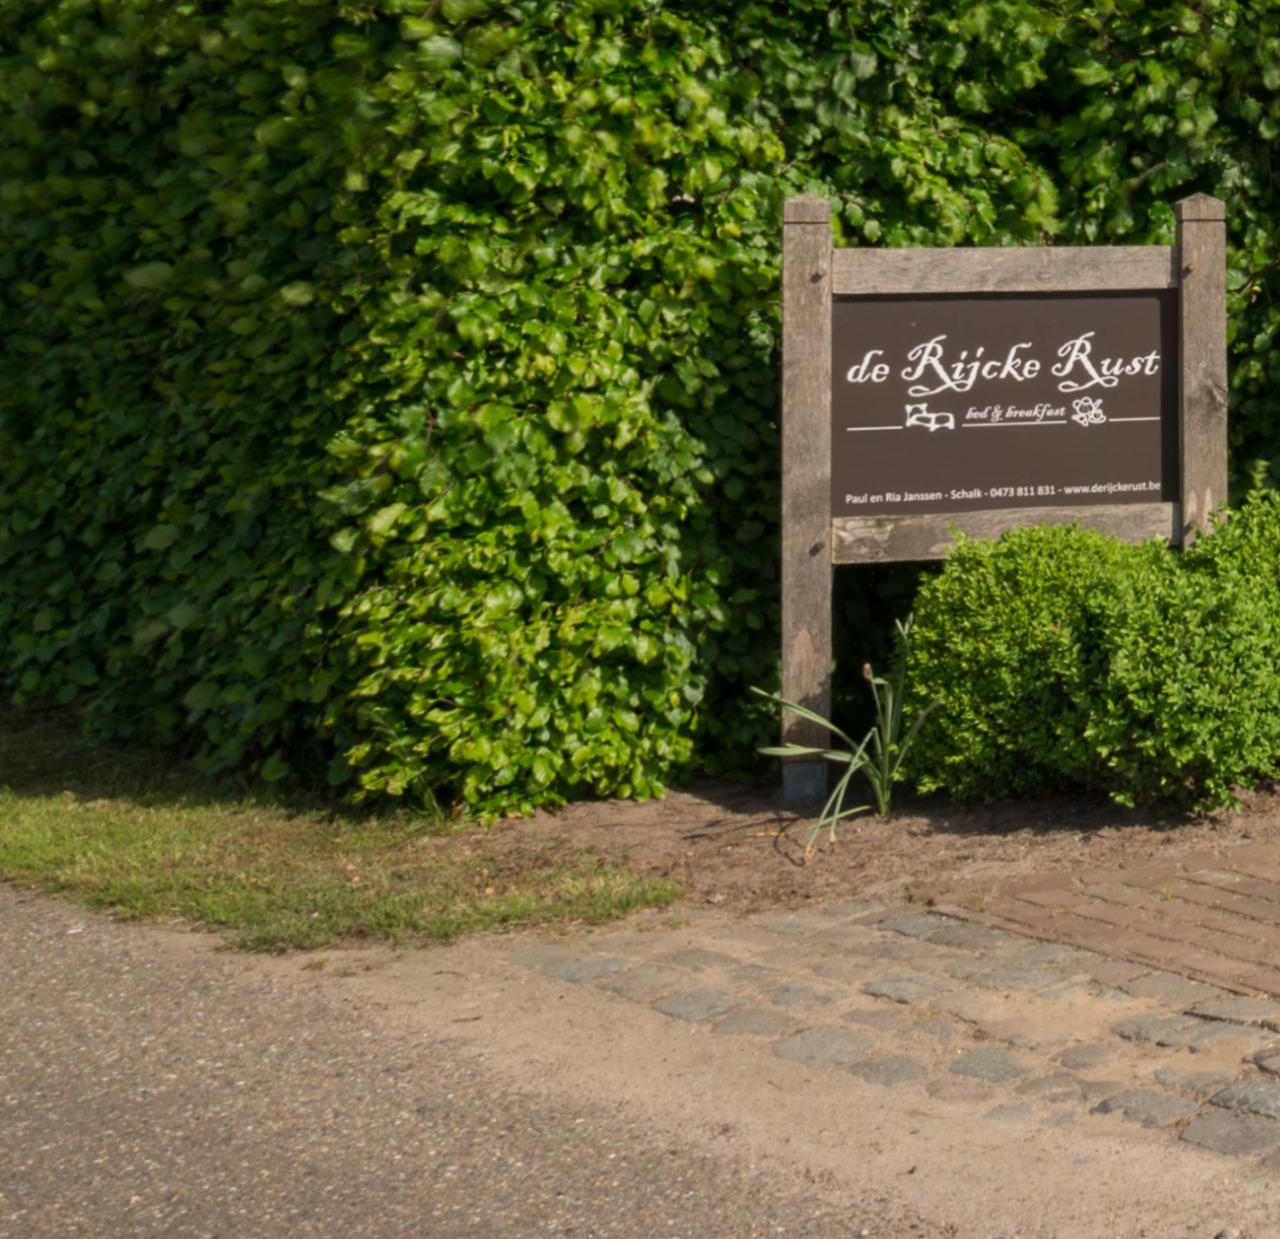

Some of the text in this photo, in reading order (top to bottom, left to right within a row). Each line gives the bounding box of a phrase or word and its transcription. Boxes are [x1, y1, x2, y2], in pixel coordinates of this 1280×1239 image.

[846, 331, 1161, 398] de Rijcke Rust
[965, 403, 1066, 423] bed & breakfast
[845, 493, 868, 504] Paul
[869, 494, 884, 503] en
[885, 492, 901, 502] Ria
[903, 491, 942, 502] Janssen
[950, 488, 983, 500] Schalk
[989, 487, 1015, 498] 0473
[1017, 486, 1034, 497] 811
[1037, 485, 1055, 496] 831
[1063, 480, 1161, 495] www.derijckerust.be
